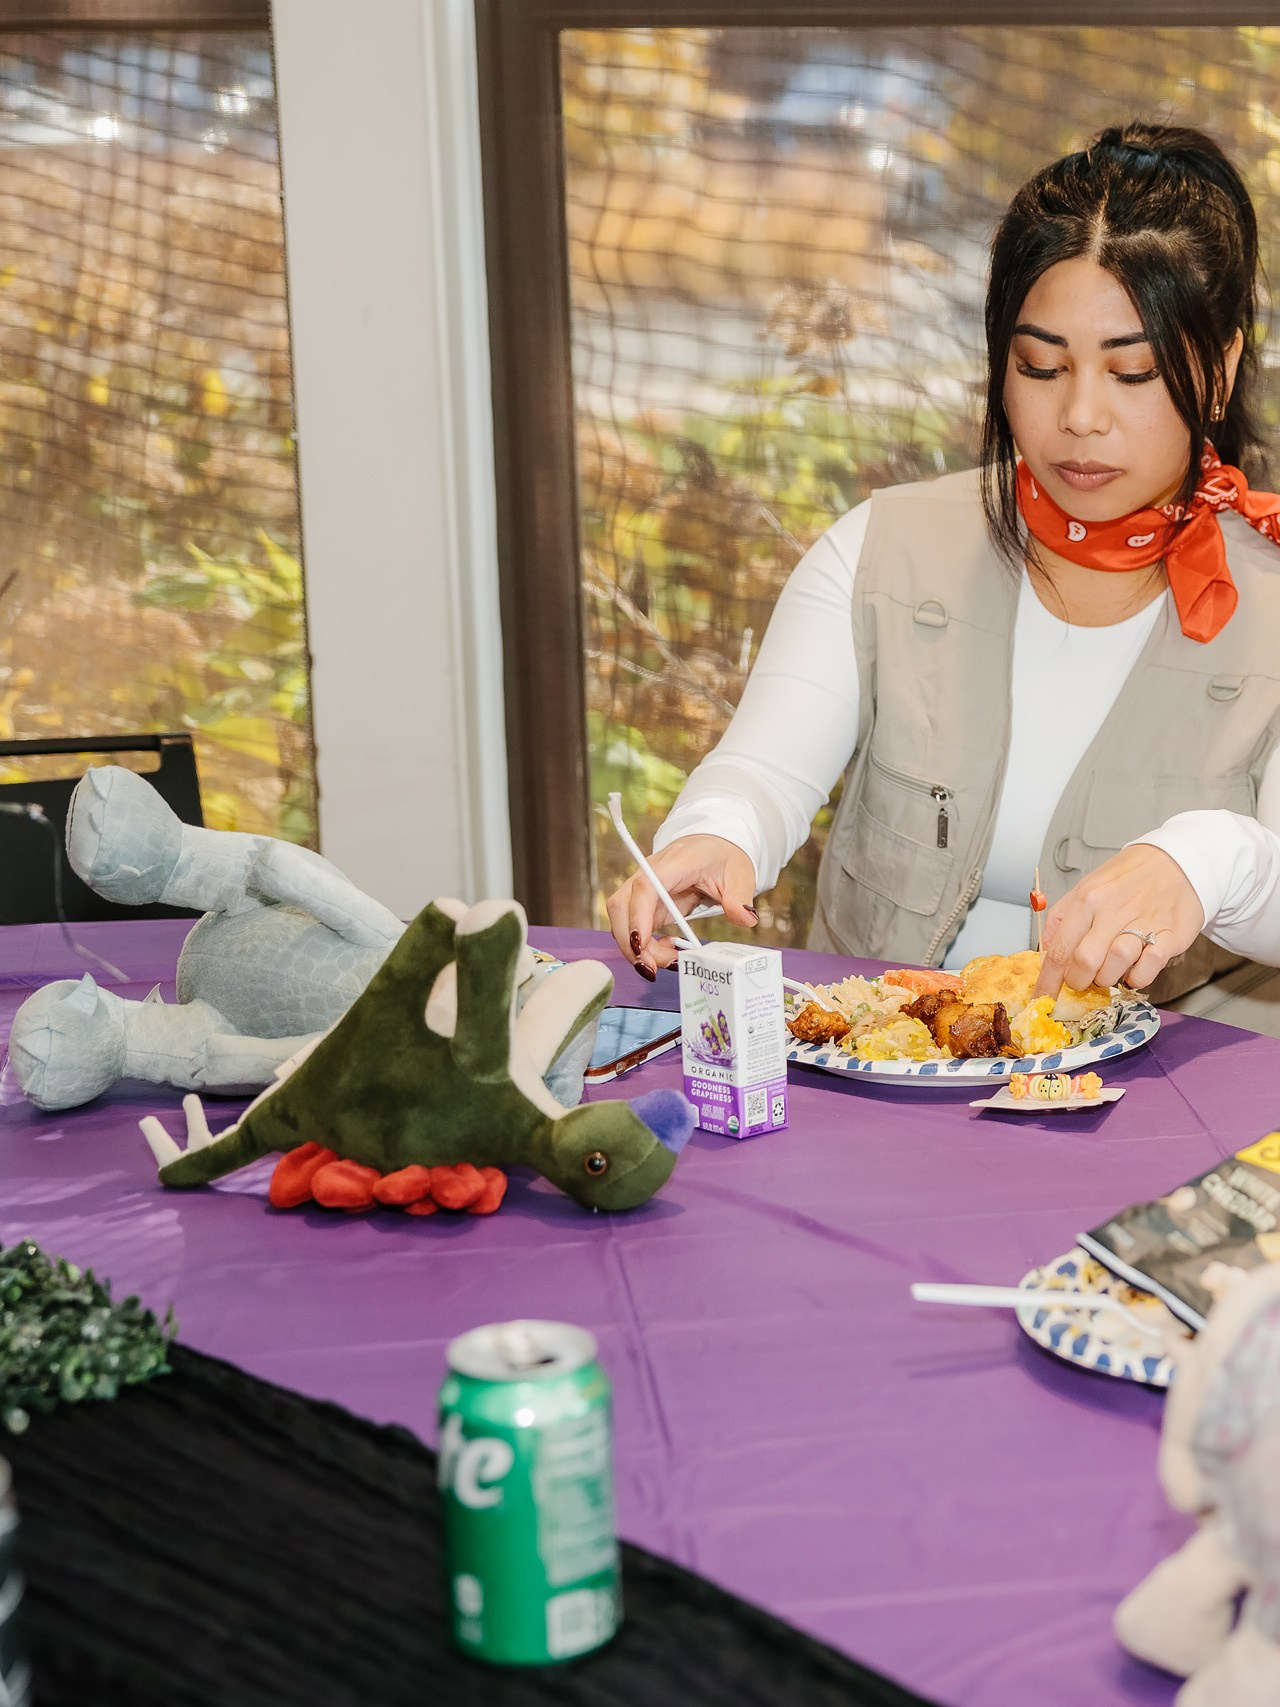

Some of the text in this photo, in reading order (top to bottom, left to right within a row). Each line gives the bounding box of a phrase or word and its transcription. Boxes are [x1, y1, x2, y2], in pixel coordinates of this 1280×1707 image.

[683, 960, 733, 986] Honest
[699, 981, 720, 996] KIDS
[691, 1066, 734, 1082] ORGANIC
[691, 1080, 731, 1095] GOODNESS
[691, 1088, 732, 1103] GRAPENESS
